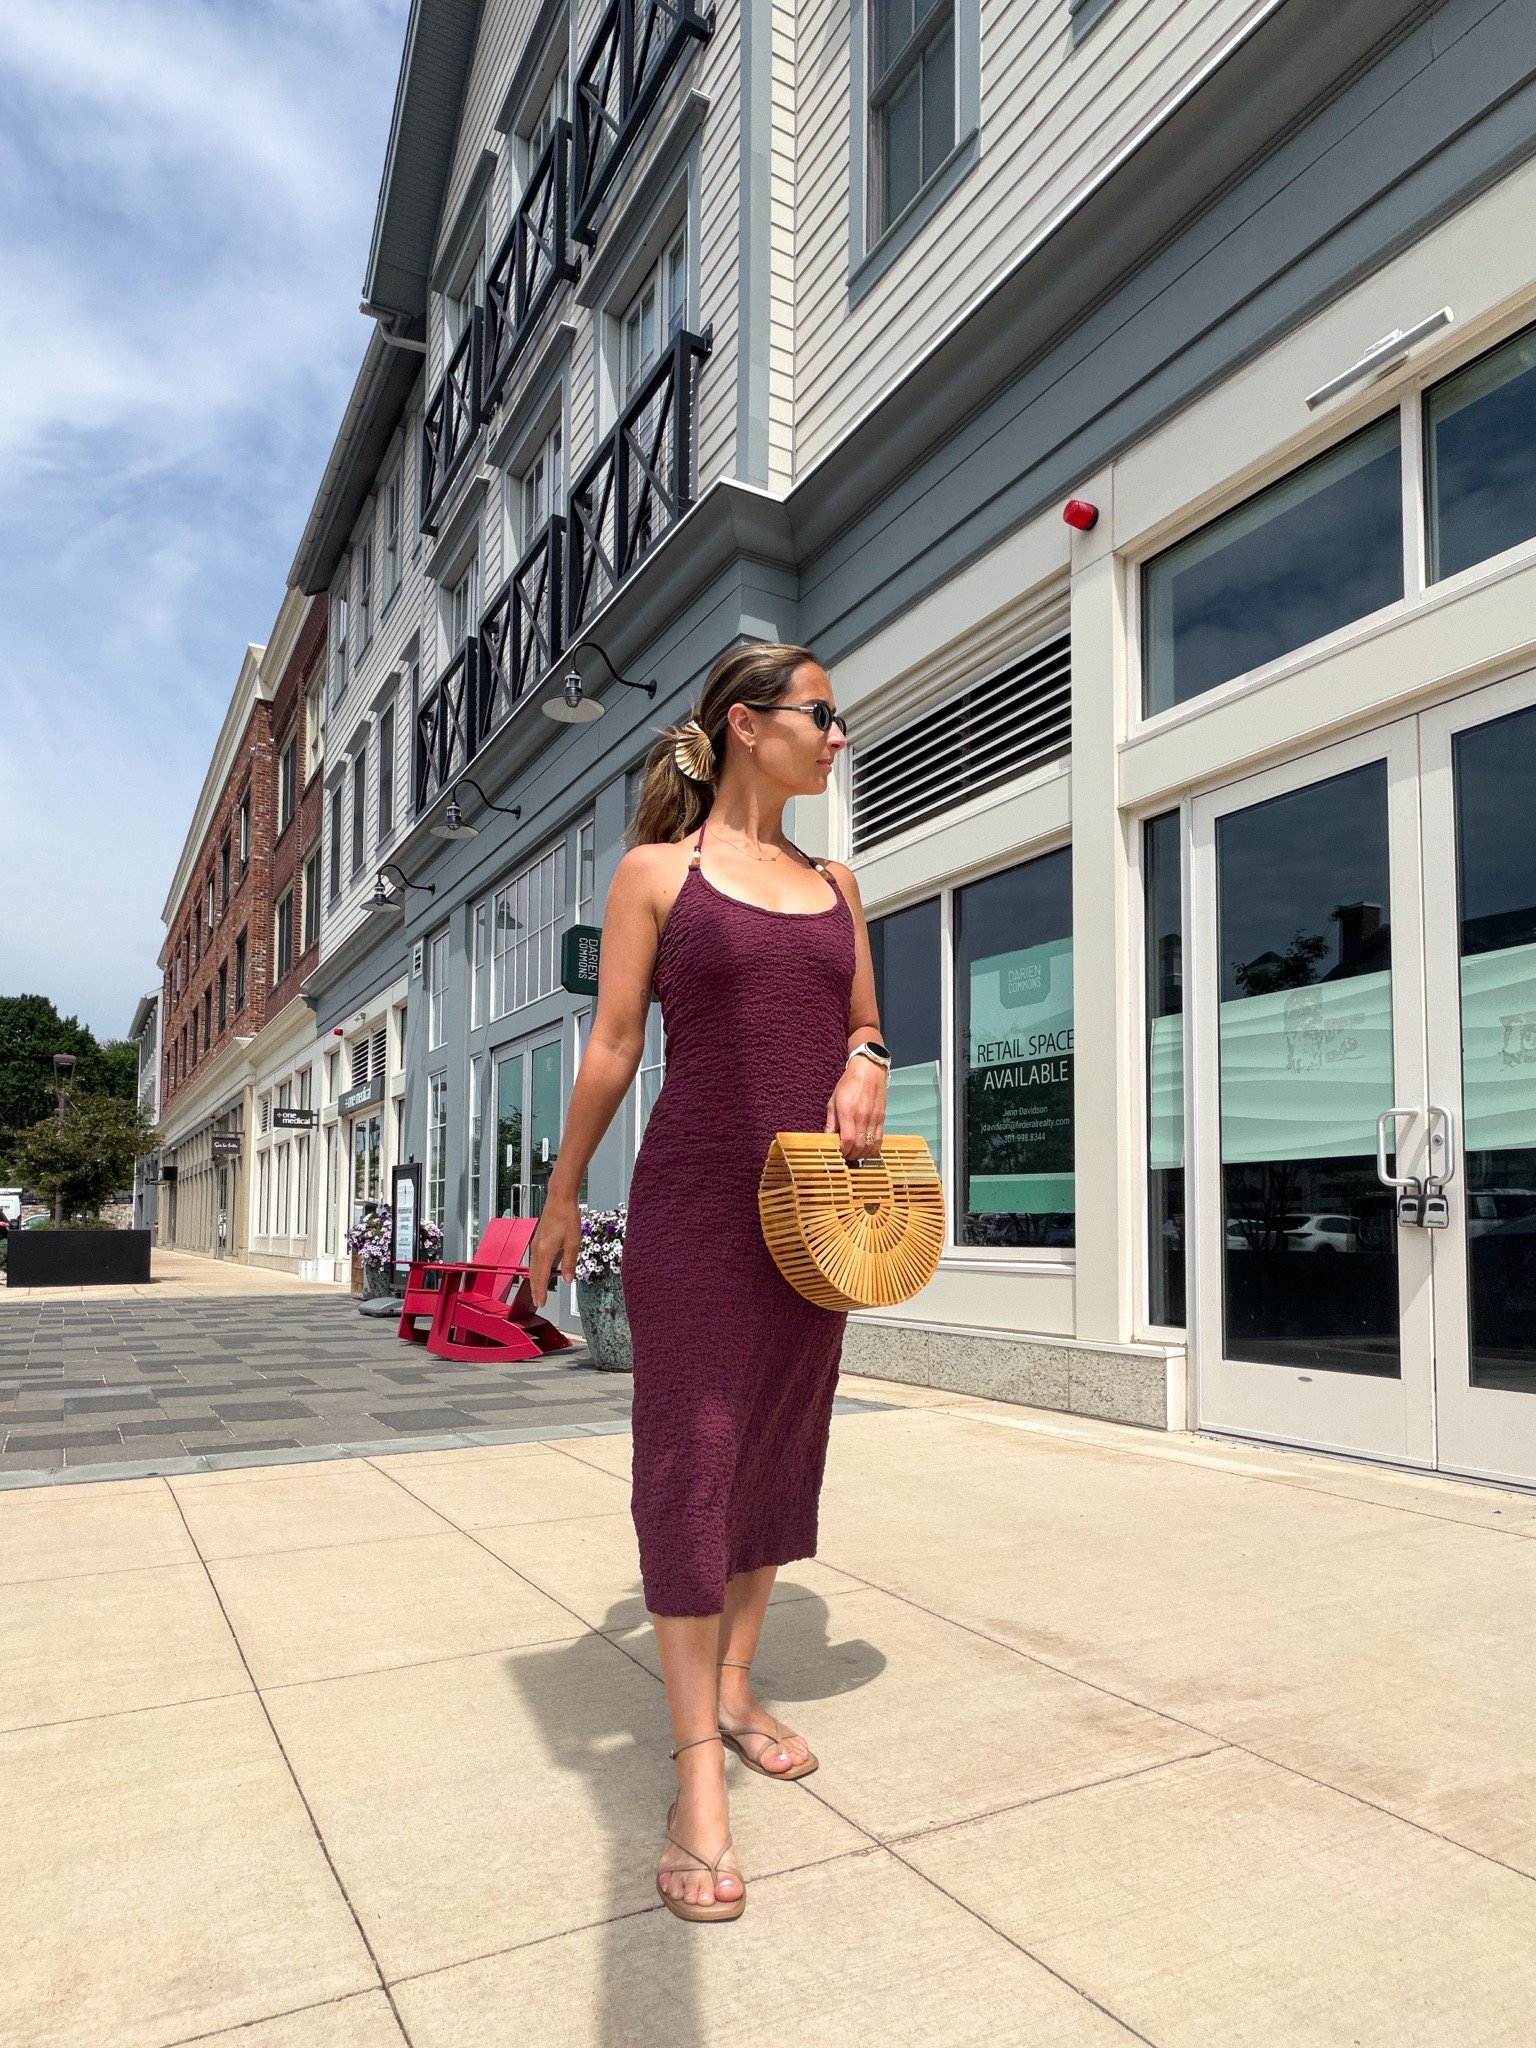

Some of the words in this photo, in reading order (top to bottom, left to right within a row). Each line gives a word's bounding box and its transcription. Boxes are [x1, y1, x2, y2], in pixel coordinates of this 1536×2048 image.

[578, 937, 589, 979] COMMONS
[588, 938, 599, 981] DARIEN
[1008, 964, 1041, 983] DARIEN
[1008, 976, 1041, 994] COMMONS
[977, 1038, 1025, 1063] RETAIL
[1028, 1028, 1074, 1056] SPACE
[983, 1060, 1069, 1091] AVAILABLE
[282, 1117, 311, 1125] medical
[1002, 1108, 1018, 1117] Jenn
[1019, 1105, 1048, 1116] Davidson
